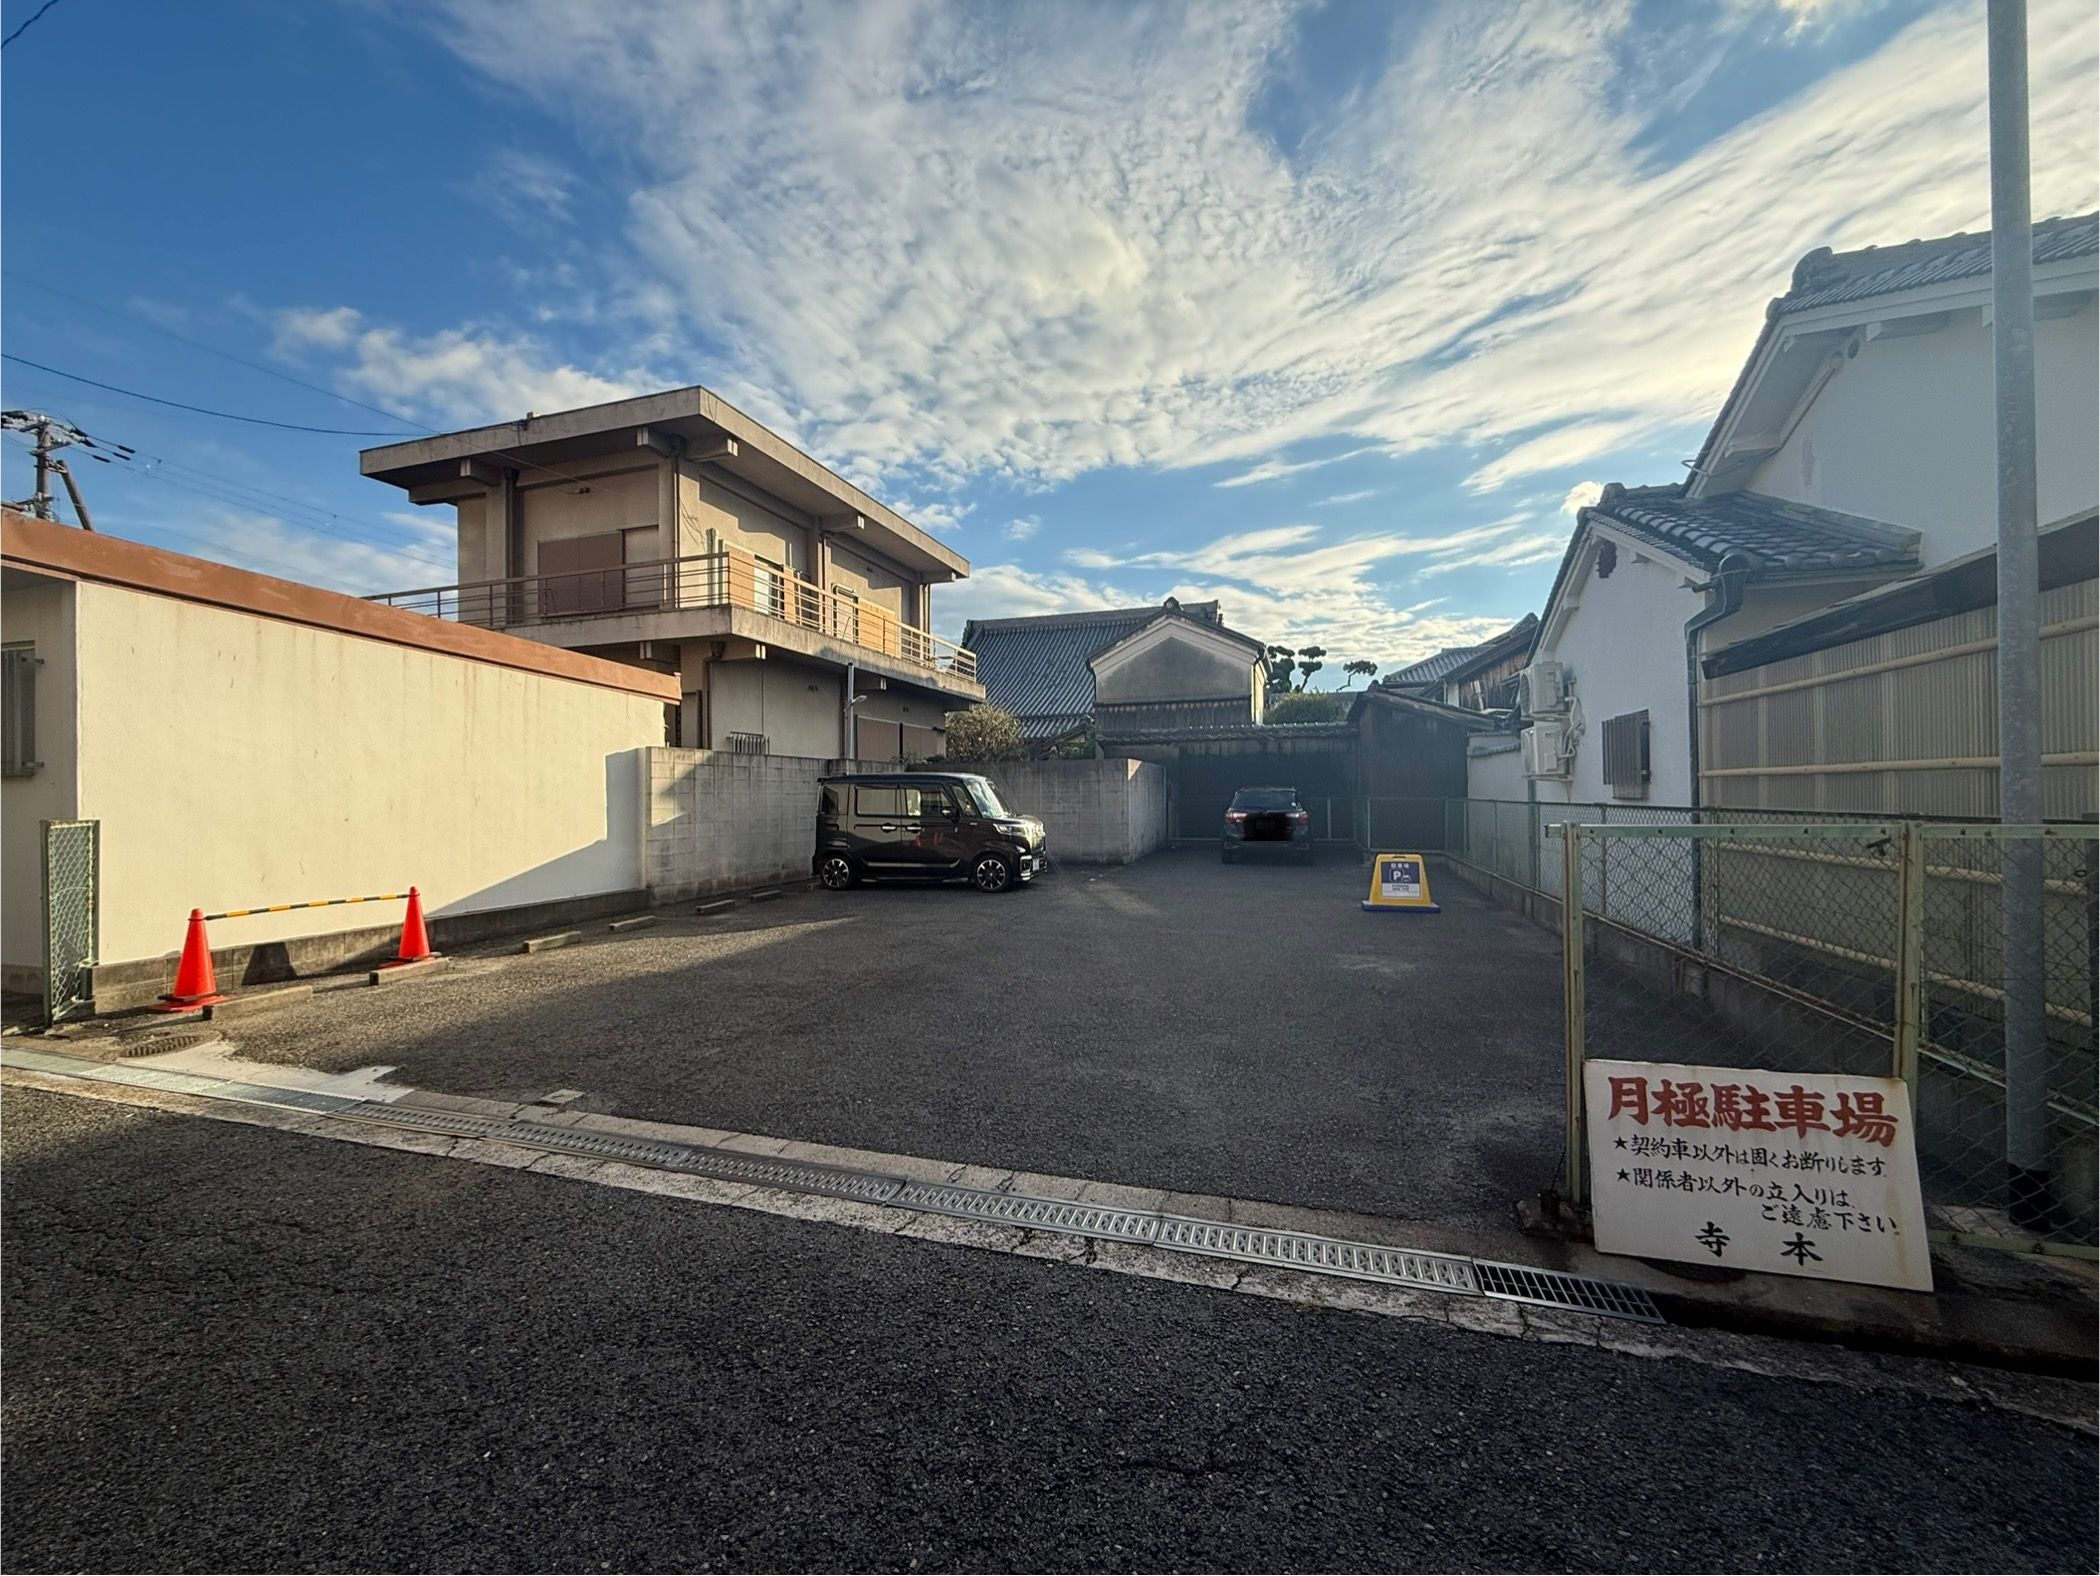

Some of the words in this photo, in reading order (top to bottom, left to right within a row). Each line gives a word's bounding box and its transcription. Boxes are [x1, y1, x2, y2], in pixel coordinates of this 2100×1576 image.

[1608, 1076, 1898, 1147] 月極駐車場
